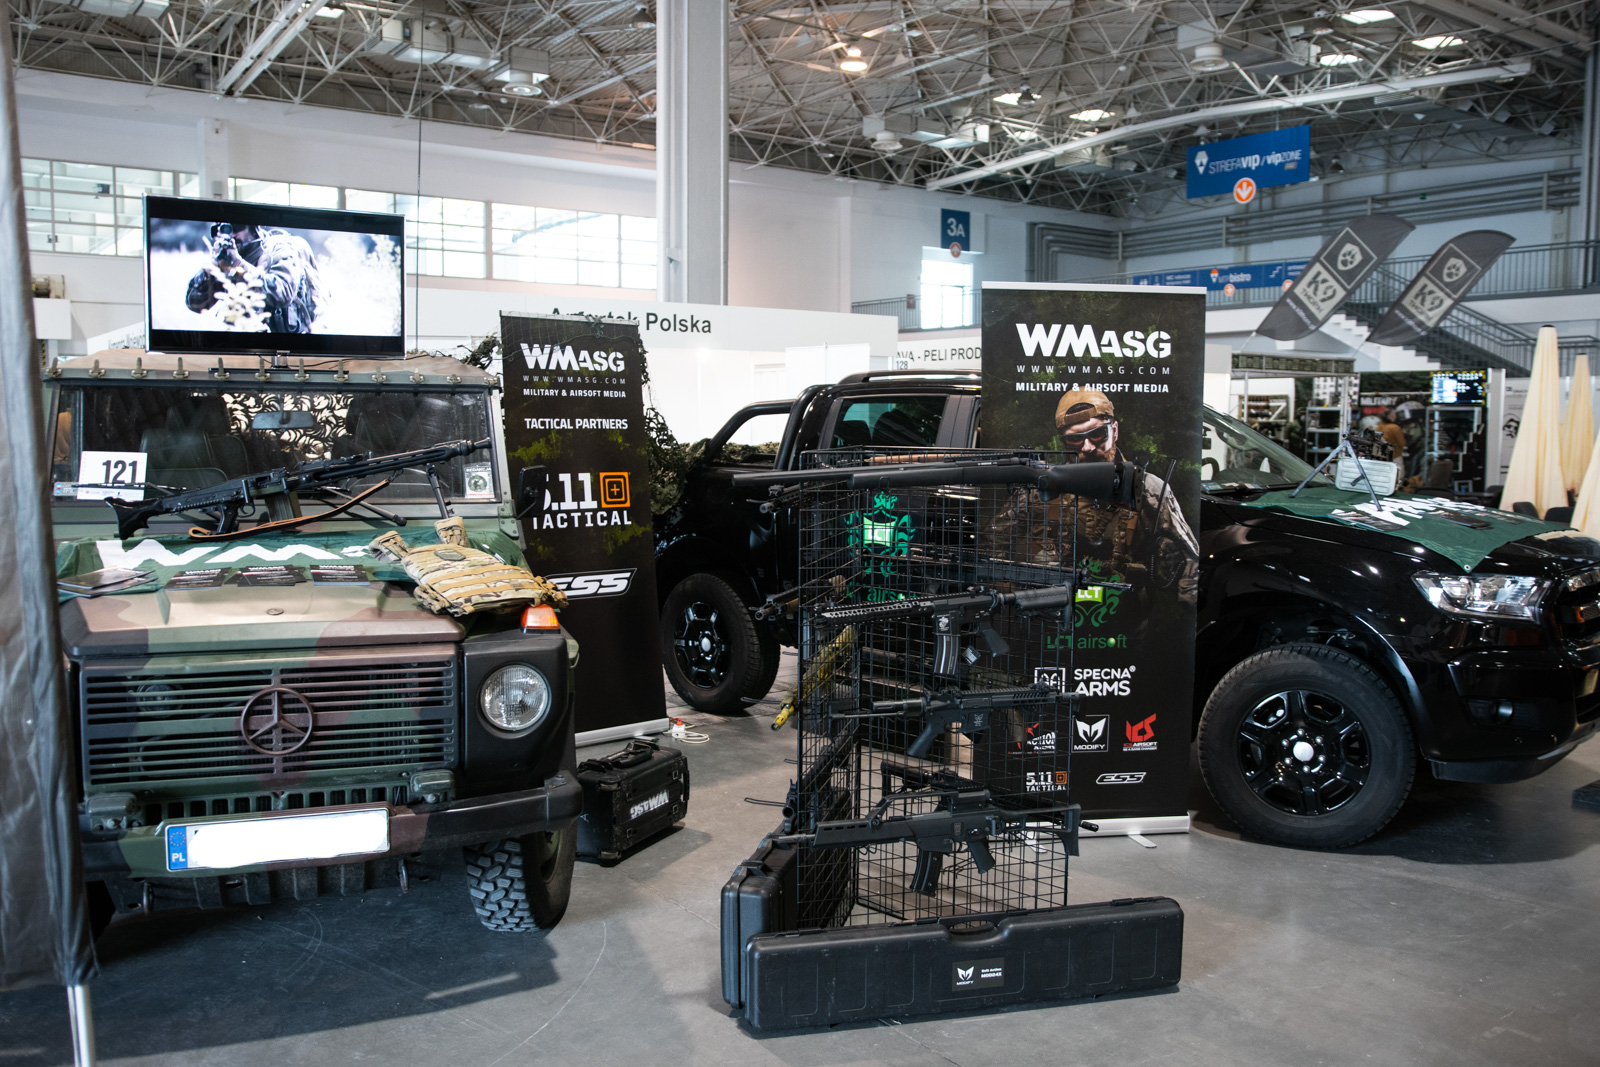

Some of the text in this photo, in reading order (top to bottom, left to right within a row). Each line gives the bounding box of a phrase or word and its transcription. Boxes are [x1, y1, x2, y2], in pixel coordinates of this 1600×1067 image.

[947, 217, 966, 237] 3A
[1306, 270, 1337, 303] K9
[1413, 283, 1444, 312] K9
[645, 312, 712, 334] Polska
[1015, 323, 1172, 359] WMASG
[520, 343, 626, 373] WMASG
[924, 349, 948, 362] PELI
[523, 388, 626, 398] MILITARY & AIRSOFT MEDIA
[1015, 382, 1170, 394] MILITARY & AIRSOFT MEDIA
[524, 418, 628, 430] TACTICAL PARTNERS
[102, 460, 138, 485] 121
[1077, 633, 1127, 649] airsoft
[1075, 680, 1131, 697] ARMS
[1073, 743, 1105, 751] MODIFY
[1099, 773, 1144, 783] ESS
[171, 852, 186, 863] PL
